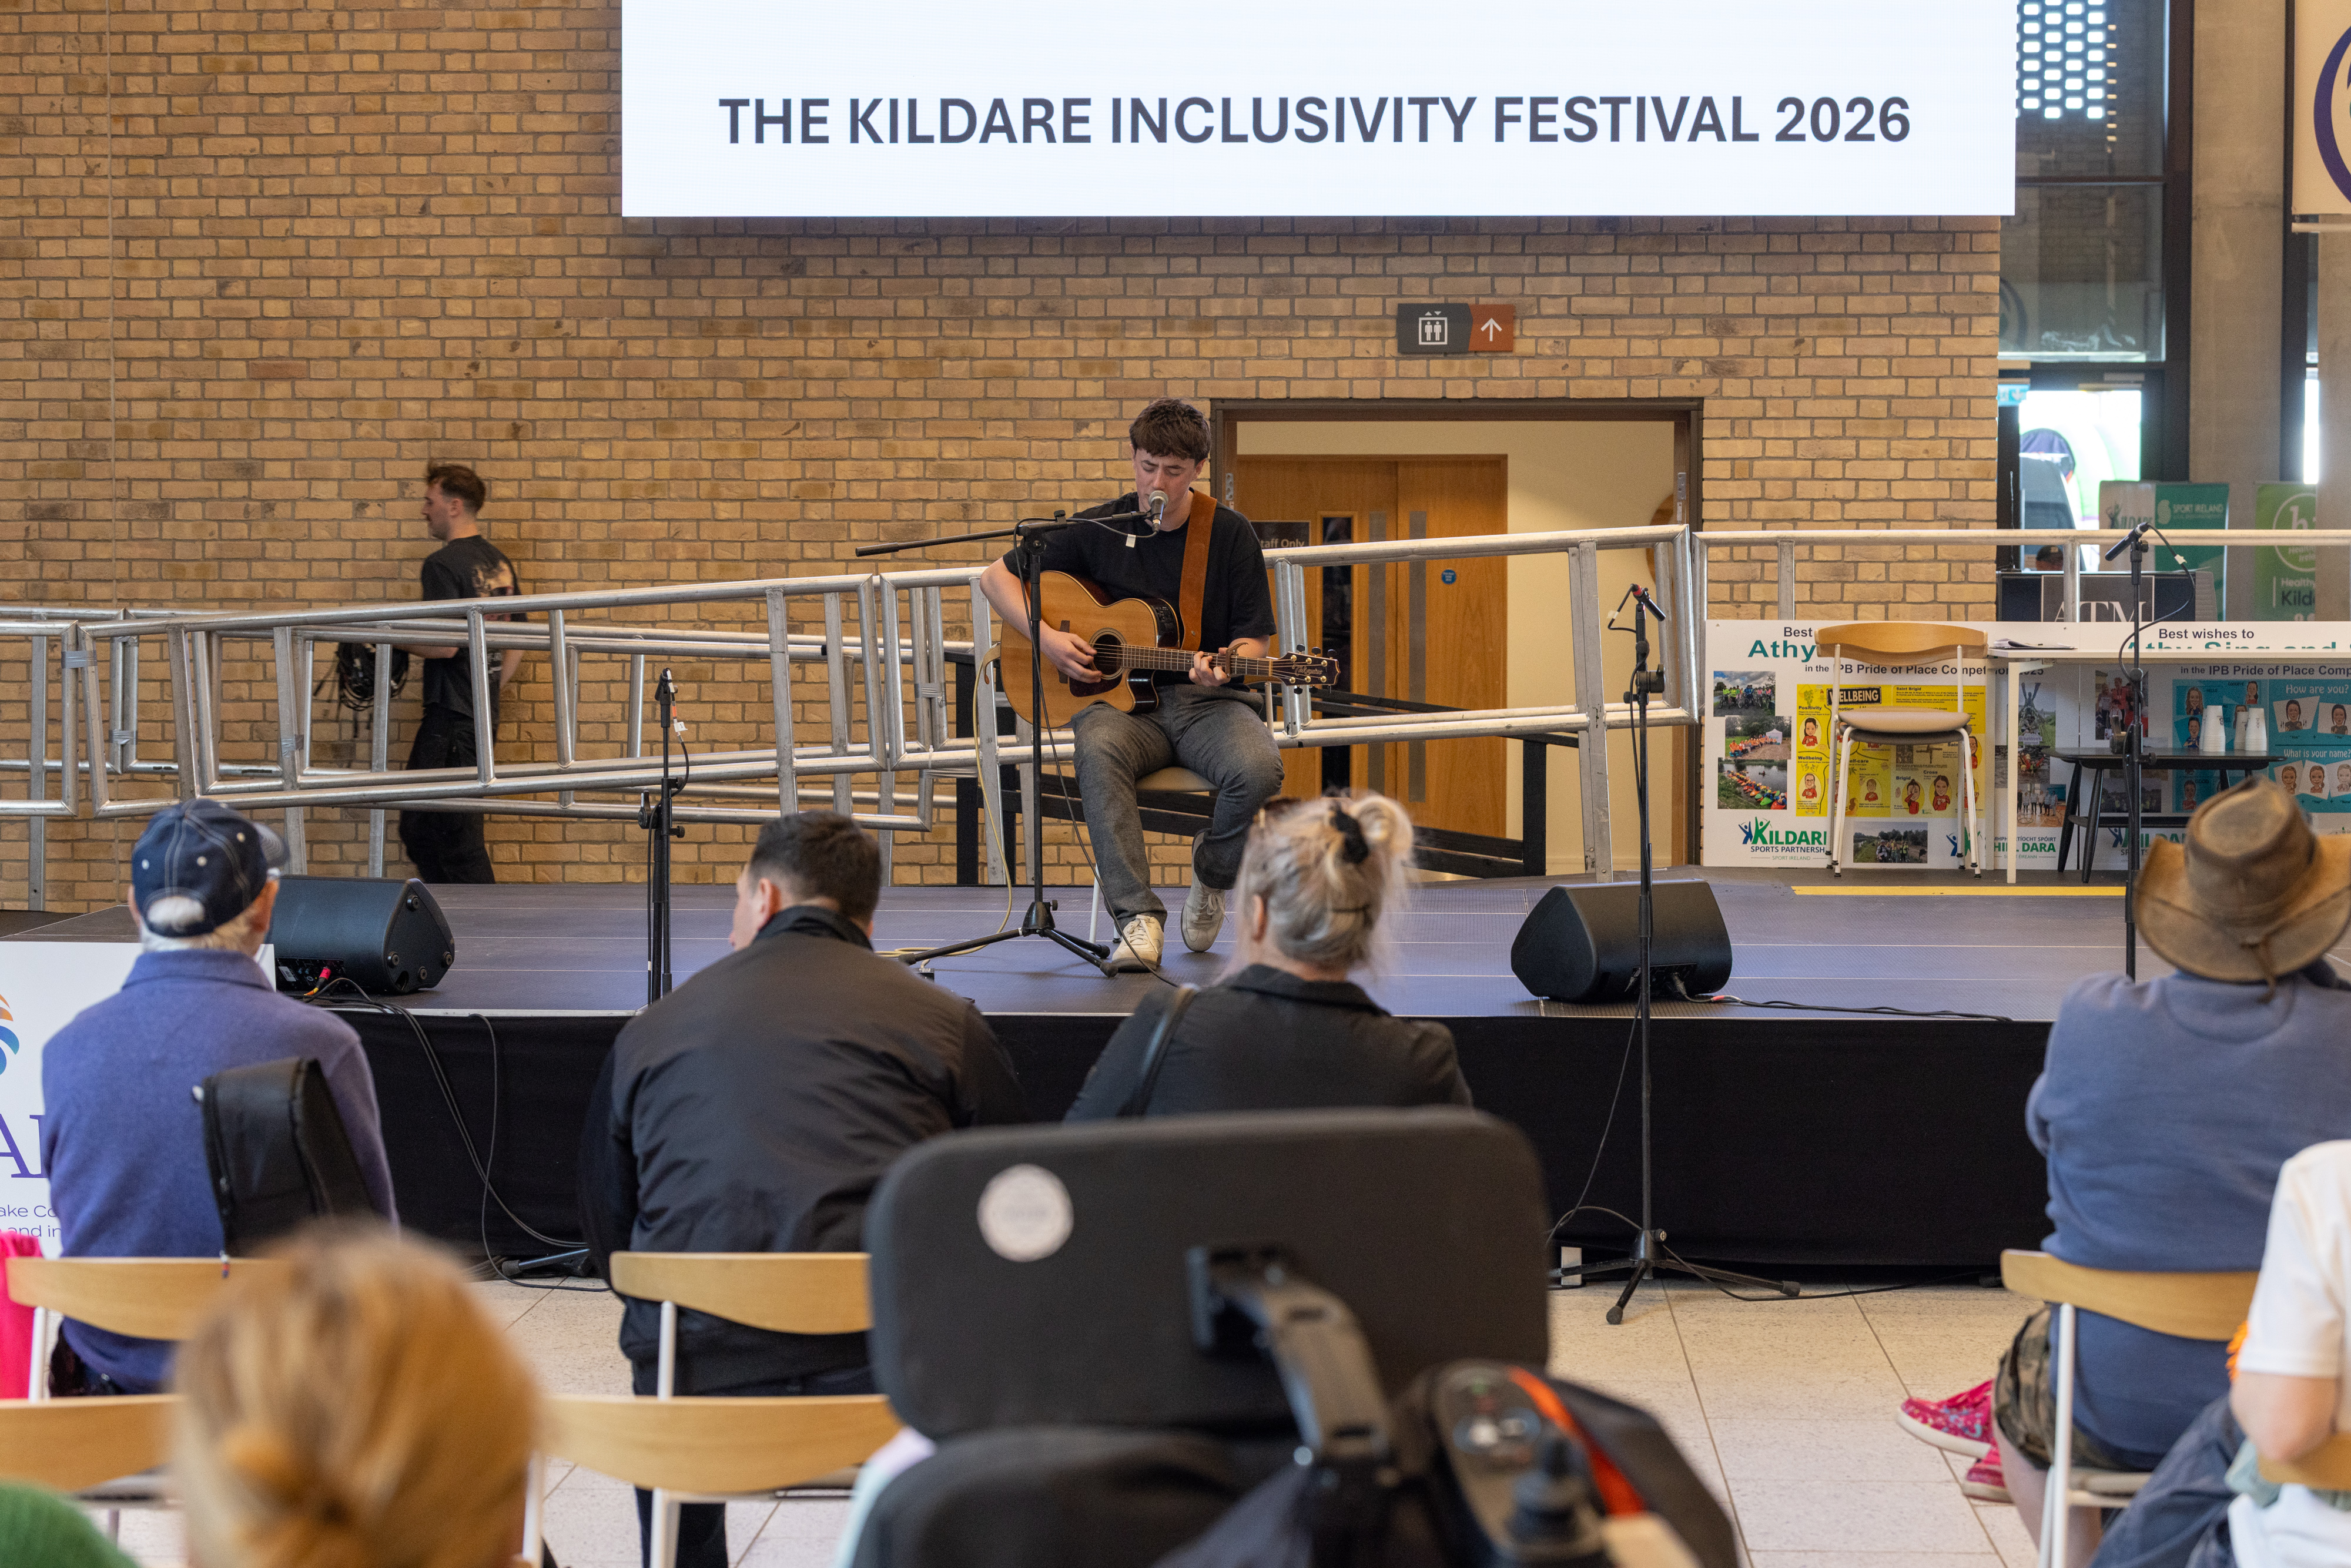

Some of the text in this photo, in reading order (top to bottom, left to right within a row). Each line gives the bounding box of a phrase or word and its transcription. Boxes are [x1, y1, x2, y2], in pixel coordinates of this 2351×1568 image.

[719, 96, 1910, 144] THE KILDARE INCLUSIVITY FESTIVAL 2026
[1258, 538, 1305, 548] taff Only
[1784, 627, 1813, 637] Best
[2159, 628, 2255, 639] Best wishes to
[1747, 640, 1817, 663] Athy
[1834, 664, 1853, 674] PB
[1857, 664, 1887, 674] Pride
[1891, 665, 1903, 674] of
[1906, 665, 1938, 675] Place
[2181, 666, 2189, 674] in
[2192, 666, 2205, 674] the
[2209, 666, 2229, 675] IPB
[2233, 665, 2263, 675] Pride
[2268, 665, 2280, 675] of
[2283, 666, 2315, 675] Place
[1830, 689, 1879, 702] ELLBEING
[2286, 685, 2308, 694] How
[2327, 685, 2349, 695] you?
[2283, 749, 2351, 759] What is your name?
[2022, 842, 2057, 853] DARA
